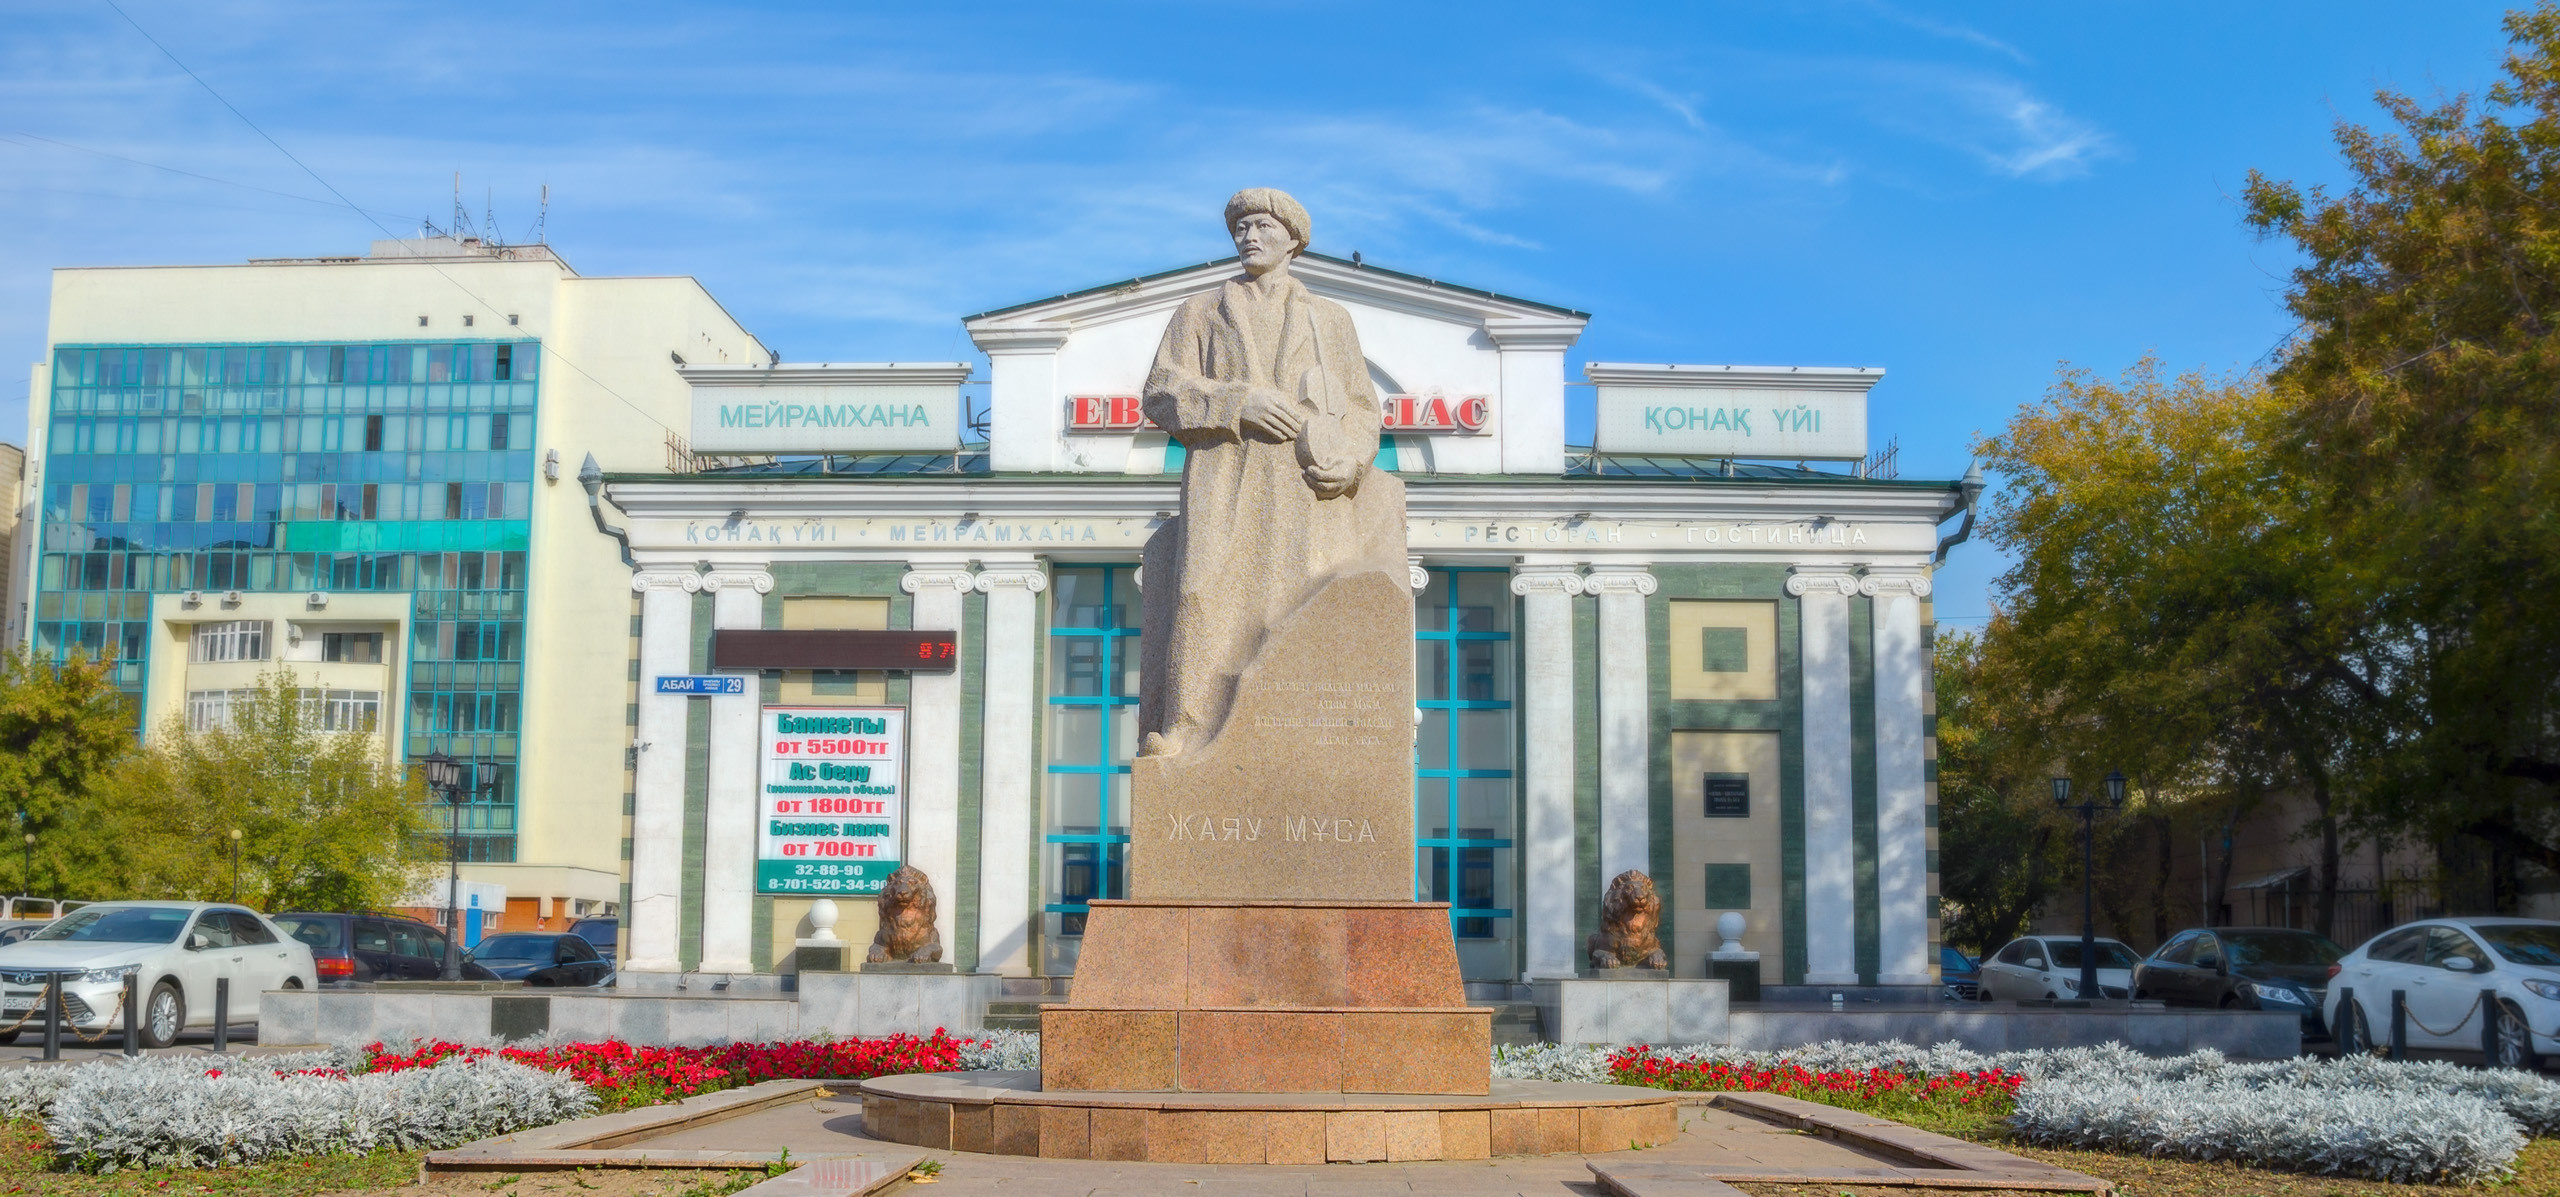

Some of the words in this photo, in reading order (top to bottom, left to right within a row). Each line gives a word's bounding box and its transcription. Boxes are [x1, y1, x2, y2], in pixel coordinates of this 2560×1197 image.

[720, 400, 930, 428] МЕЙРАМХАНА
[1070, 395, 1154, 429] ЕВ
[1645, 406, 1751, 437] ҚОНАҚ
[1772, 404, 1821, 433] ҮЙІ
[890, 521, 1097, 542] МЕЙРАМХАНА
[1465, 525, 1622, 543] РЕСТОРАН
[1686, 527, 1867, 547] ГОСТИНИЦА
[661, 677, 694, 690] АБАЙ
[726, 678, 742, 692] 29
[777, 713, 887, 734] Банкеты
[776, 741, 802, 754] от
[807, 739, 889, 755] 5500тг
[789, 762, 816, 781] Ас
[819, 762, 871, 783] беру
[777, 800, 802, 813] от
[807, 798, 885, 814] 1800тг
[770, 820, 839, 836] Бизнес
[842, 823, 890, 837] ланч
[1168, 812, 1262, 842] ЖАЯУ
[1285, 813, 1376, 843] МҰСА
[782, 843, 809, 856] от
[813, 841, 877, 857] 700тг
[795, 864, 863, 876] 32-88-90
